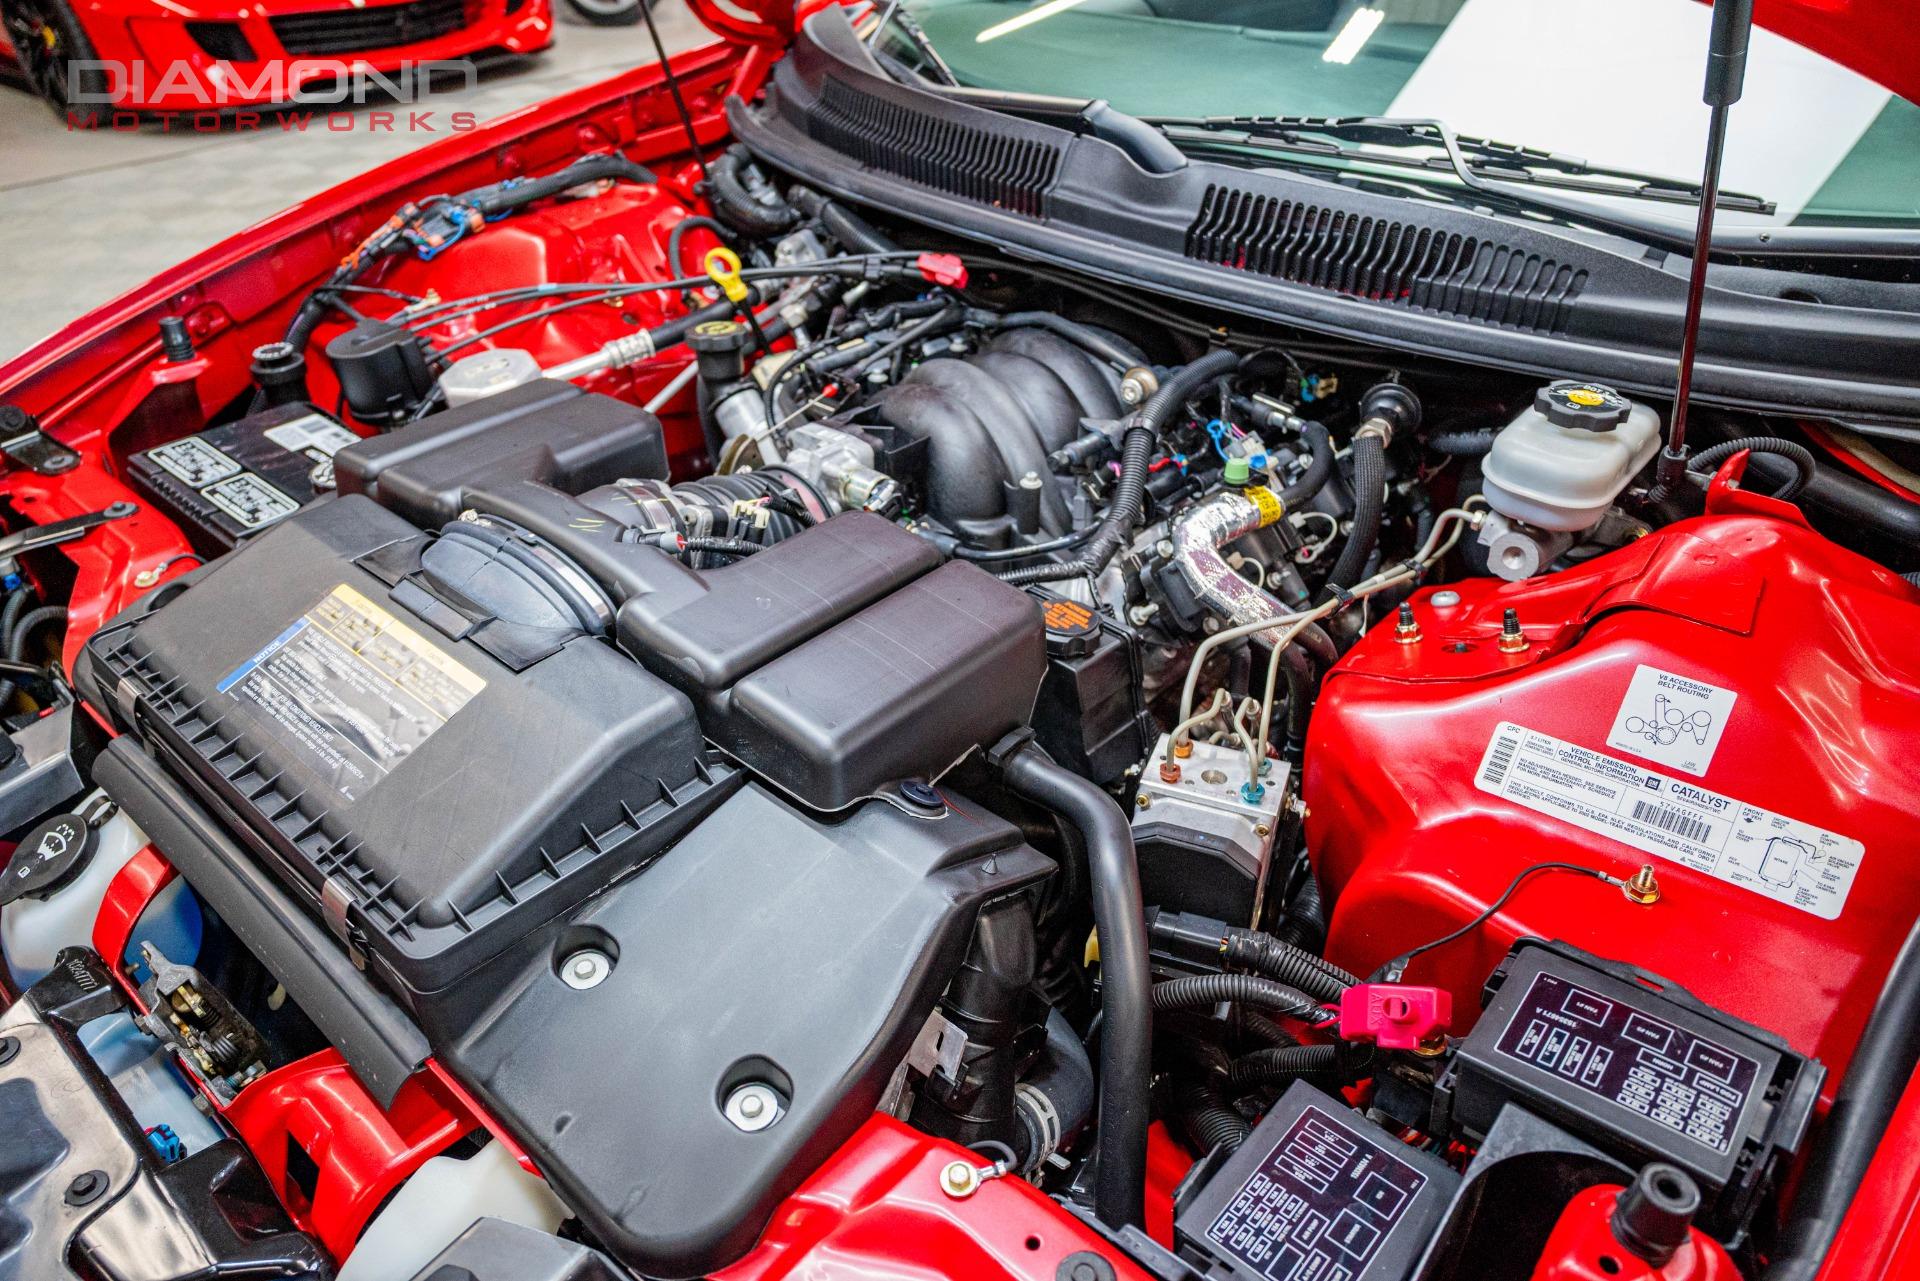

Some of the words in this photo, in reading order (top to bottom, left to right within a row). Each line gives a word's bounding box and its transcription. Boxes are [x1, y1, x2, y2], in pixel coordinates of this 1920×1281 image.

[252, 639, 282, 663] NOTICE
[1657, 679, 1676, 689] BELT
[1676, 685, 1709, 699] ROUTING
[1669, 677, 1712, 694] ACCESSORY
[1558, 749, 1592, 765] CONTROL
[1594, 762, 1644, 783] INFORMATION
[1570, 747, 1600, 761] VEHICLE
[1602, 757, 1636, 773] EMISSION
[1526, 769, 1540, 777] MORE
[1527, 760, 1562, 775] ADJUSTMENTS
[1595, 784, 1616, 794] SERVICE
[1560, 757, 1582, 767] GENERAL
[1583, 765, 1601, 773] MOTORS
[1602, 771, 1640, 787] CORPORATION
[1551, 773, 1586, 788] MAINTENANCE
[1670, 783, 1730, 810] CATALYST
[1744, 807, 1763, 816] FRONT
[1522, 785, 1544, 795] VEHICLE
[1545, 793, 1574, 807] CONFORMS
[1626, 823, 1664, 840] REGULATIONS
[1681, 843, 1715, 859] CALIFORNIA
[1534, 1005, 1543, 1013] A
[1583, 1003, 1598, 1013] FAN
[1643, 1029, 1659, 1039] FAN
[1651, 1056, 1674, 1070] HORN
[1707, 1057, 1723, 1068] FAN
[1698, 1078, 1719, 1092] LAMP
[1718, 1087, 1736, 1100] FOG
[1301, 1230, 1311, 1240] AIR
[1306, 1217, 1320, 1232] PUMP
